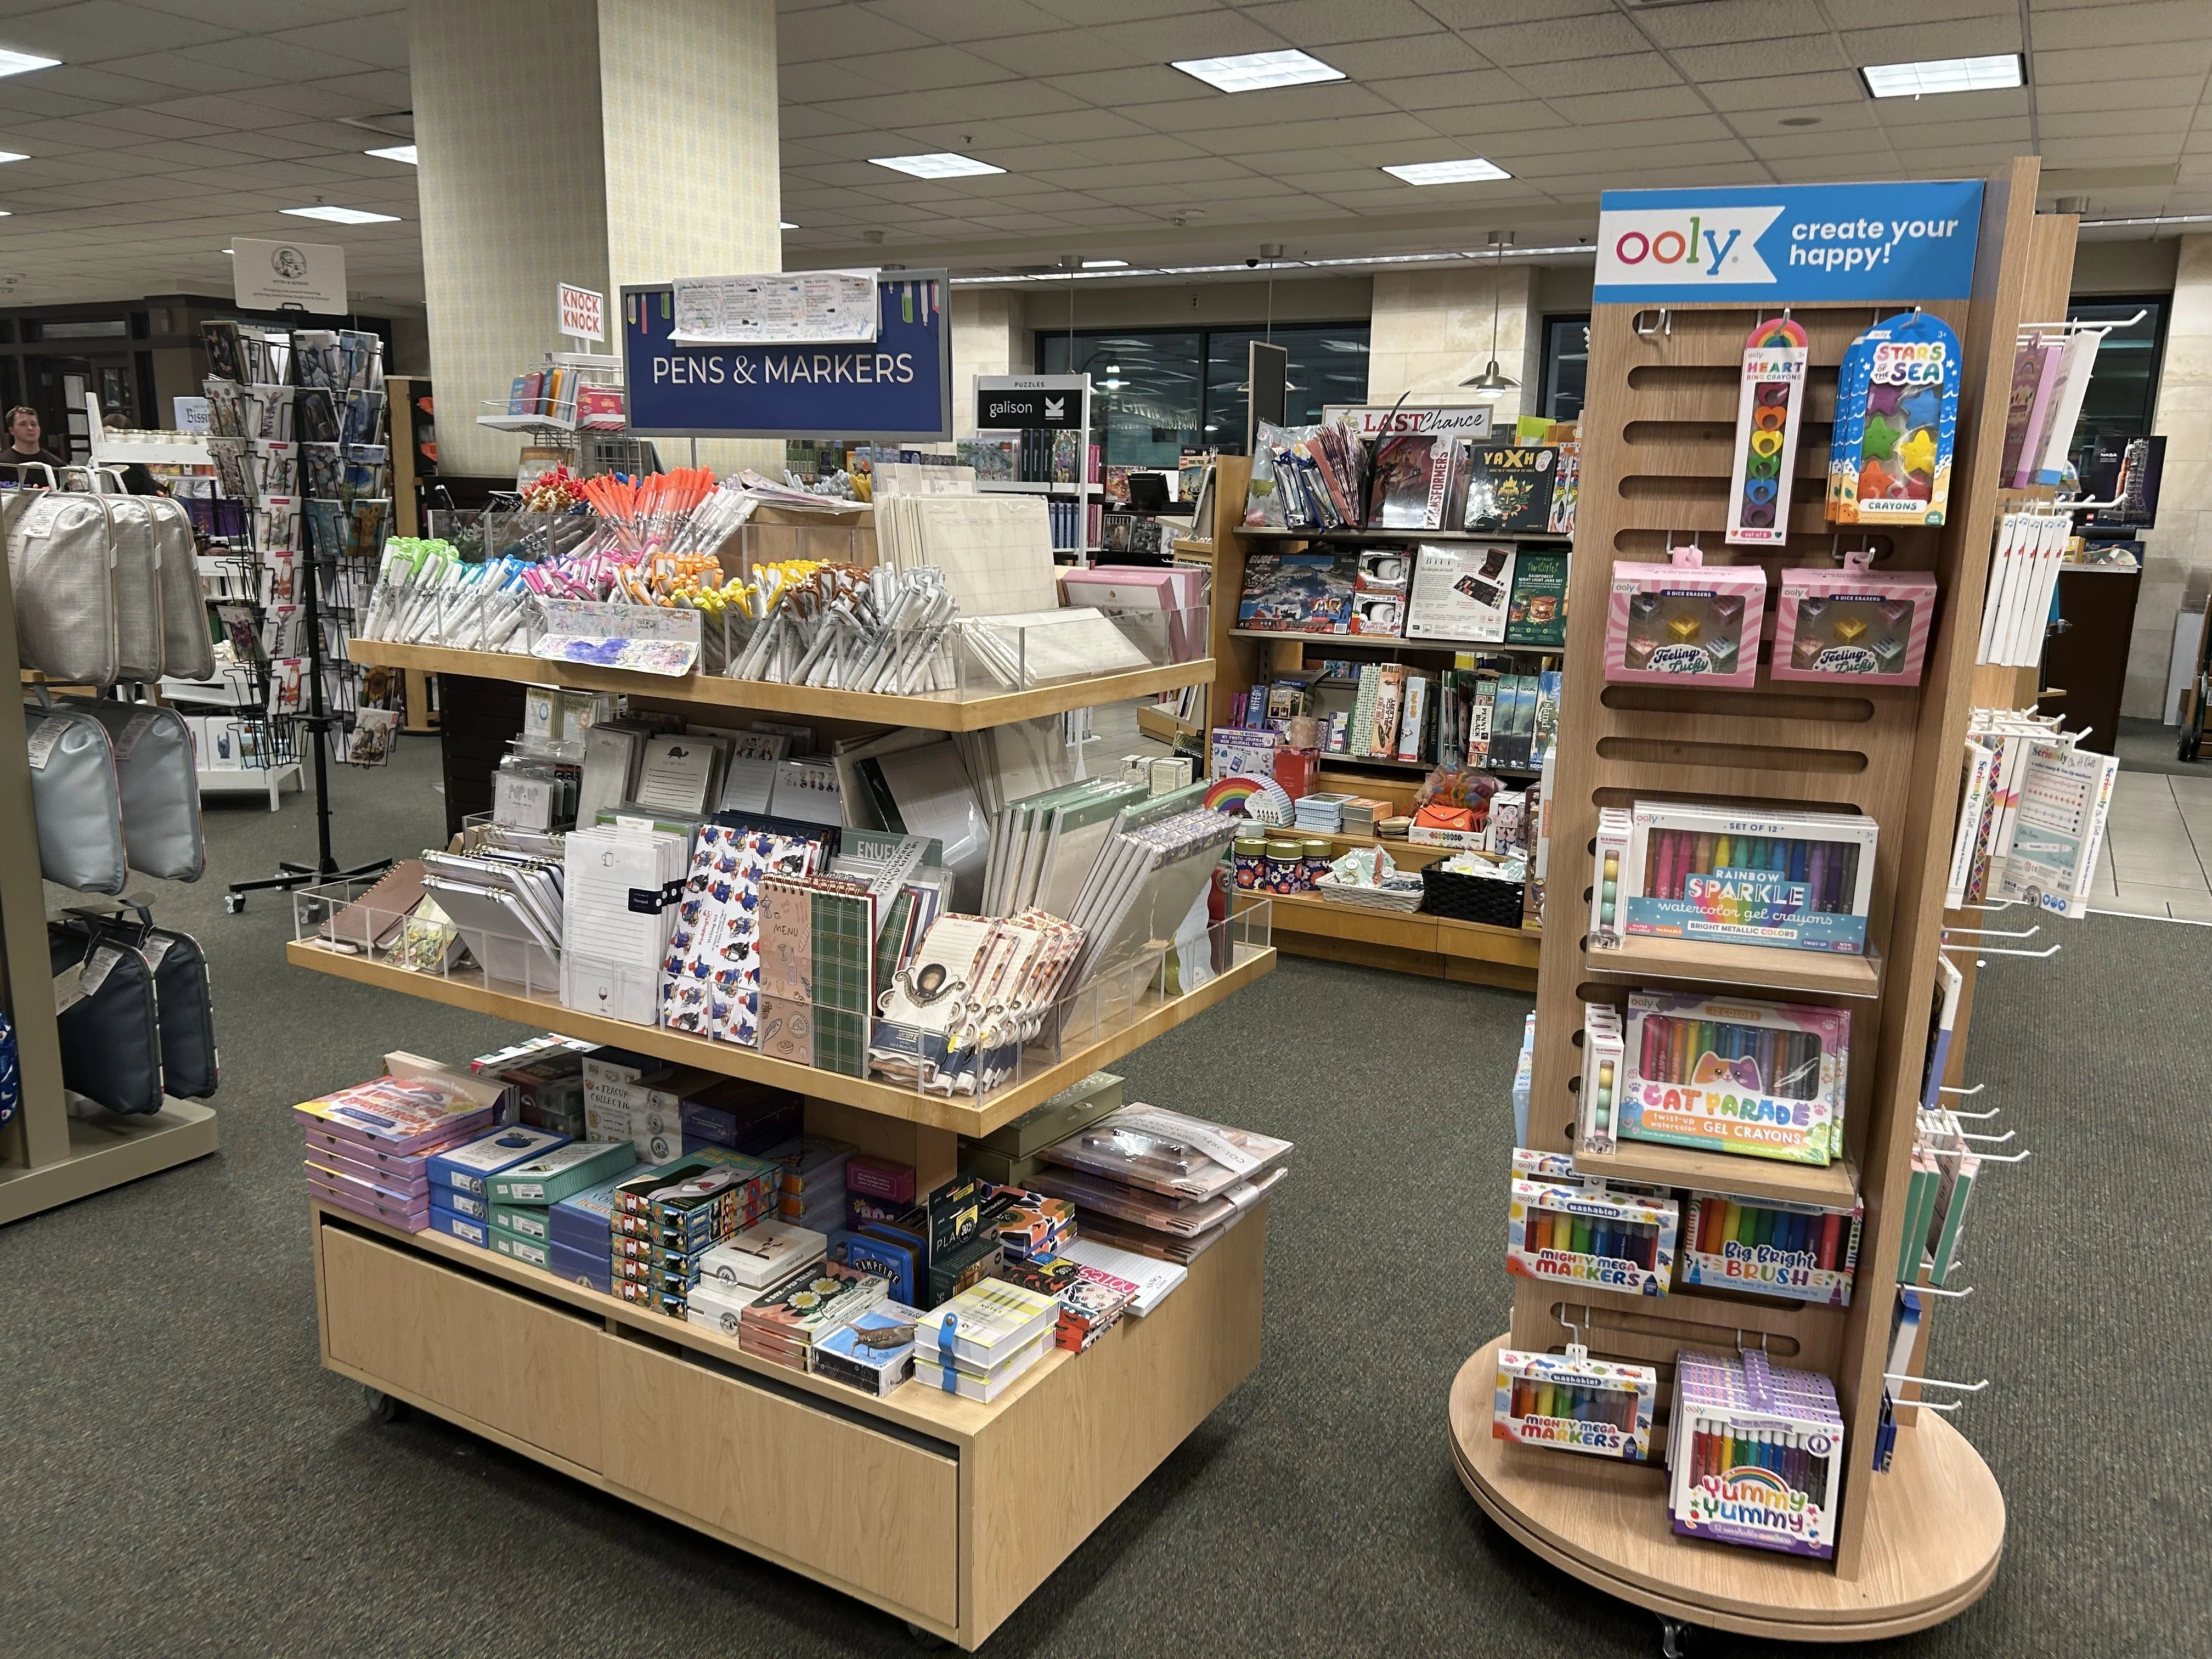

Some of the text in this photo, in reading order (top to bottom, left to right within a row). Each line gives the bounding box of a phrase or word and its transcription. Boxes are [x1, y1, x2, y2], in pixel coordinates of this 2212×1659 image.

[1792, 218, 1958, 245] create your
[1616, 217, 1741, 275] ooly
[1789, 244, 1890, 272] happy!
[563, 289, 599, 314] KNOCK
[564, 309, 600, 333] KNOCK
[1876, 345, 1943, 362] STARS
[653, 353, 913, 384] PENS & MARKERS
[1747, 362, 1803, 373] HEART
[1891, 362, 1940, 381] SEA
[187, 408, 209, 423] Bissi
[989, 400, 1032, 417] galison
[1364, 412, 1485, 432] LAST Chance
[1868, 502, 1917, 510] CRAYONS
[1616, 584, 1634, 592] ooly
[1785, 589, 1803, 597] ooly
[1654, 648, 1700, 663] Feeling
[1820, 650, 1866, 664] Feeling
[1669, 658, 1708, 674] Lucky
[1835, 659, 1875, 674] Lucky
[1252, 690, 1261, 710] KITES
[1541, 700, 1553, 728] Island
[1970, 761, 1987, 802] Seriously
[2098, 768, 2114, 809] Seriously
[1637, 813, 1658, 824] ooly
[1730, 823, 1747, 831] SET
[1768, 825, 1777, 833] 12
[904, 841, 918, 859] MENU
[874, 842, 911, 892] SHOPPING LIST
[882, 859, 906, 893] PLANNER
[1716, 869, 1779, 883] RAINBOW
[1689, 878, 1804, 905] SPARKLE
[1658, 902, 1832, 925] watercolor gel crayons
[698, 911, 710, 945] Paddington
[708, 924, 716, 943] Writing
[773, 924, 798, 936] MENU
[1691, 923, 1794, 938] BRIGHT METALLIC COLORS
[1632, 997, 1654, 1009] ooly
[591, 1093, 630, 1109] COLLECTIO
[601, 1084, 628, 1098] TEACUP
[1644, 1084, 1810, 1126] CAT PARADE
[1650, 1121, 1697, 1132] watercolor
[1654, 1113, 1695, 1125] twist-up
[1703, 1121, 1801, 1144] GEL CRAYONS
[1518, 1195, 1535, 1204] ooly
[936, 1231, 959, 1251] PLA
[1541, 1249, 1635, 1272] MIGHTY MEGA
[1725, 1241, 1752, 1262] Big
[855, 1260, 900, 1284] CAMPFIRE
[1536, 1260, 1640, 1286] MARKERS
[1726, 1260, 1809, 1285] BRUSH
[980, 1304, 1002, 1313] NOTES
[1686, 1406, 1705, 1415] ooly
[1526, 1415, 1616, 1434] MIGHTY MEGA
[1521, 1425, 1620, 1448] MARKERS
[1702, 1476, 1807, 1511] Yummy
[1703, 1498, 1804, 1532] Yummy
